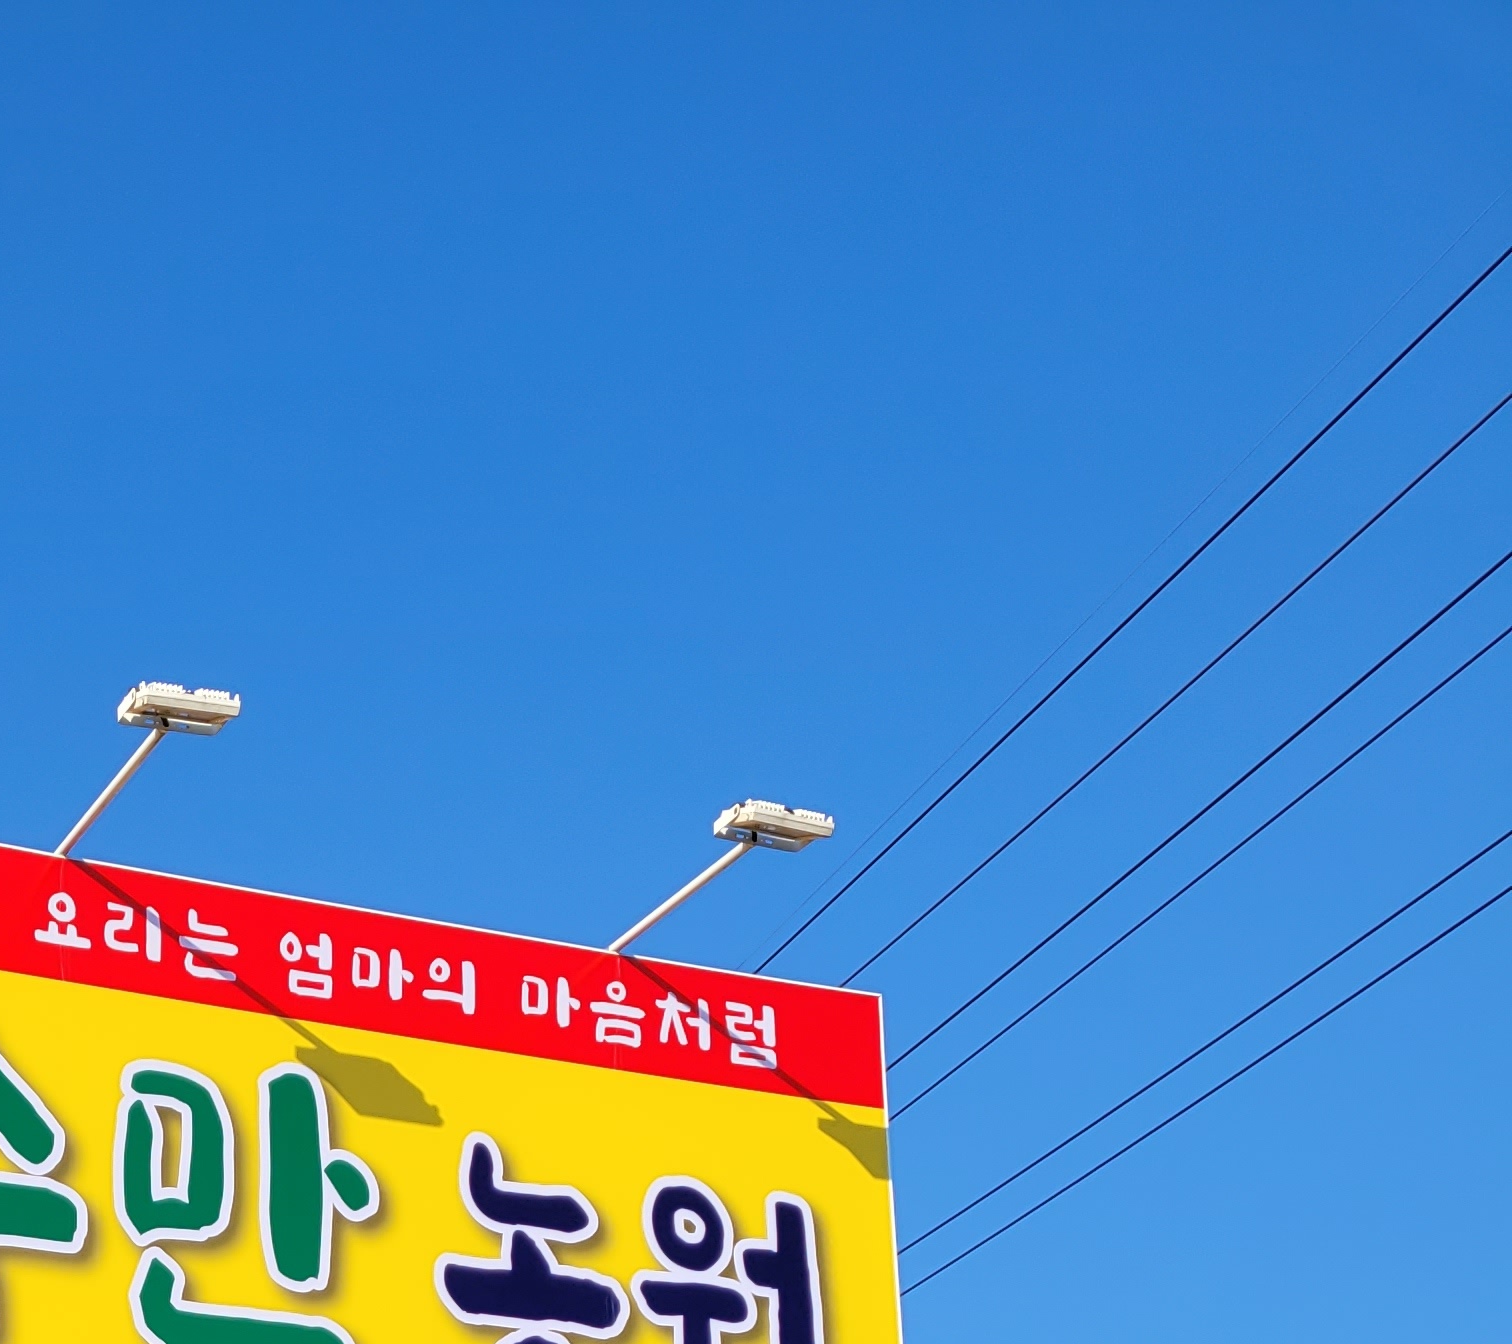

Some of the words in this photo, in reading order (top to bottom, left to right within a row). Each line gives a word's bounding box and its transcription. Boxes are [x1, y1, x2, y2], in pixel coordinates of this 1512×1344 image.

[34, 892, 239, 982] 요리는
[279, 933, 477, 1015] 엄마의
[521, 975, 778, 1069] 마음처럼
